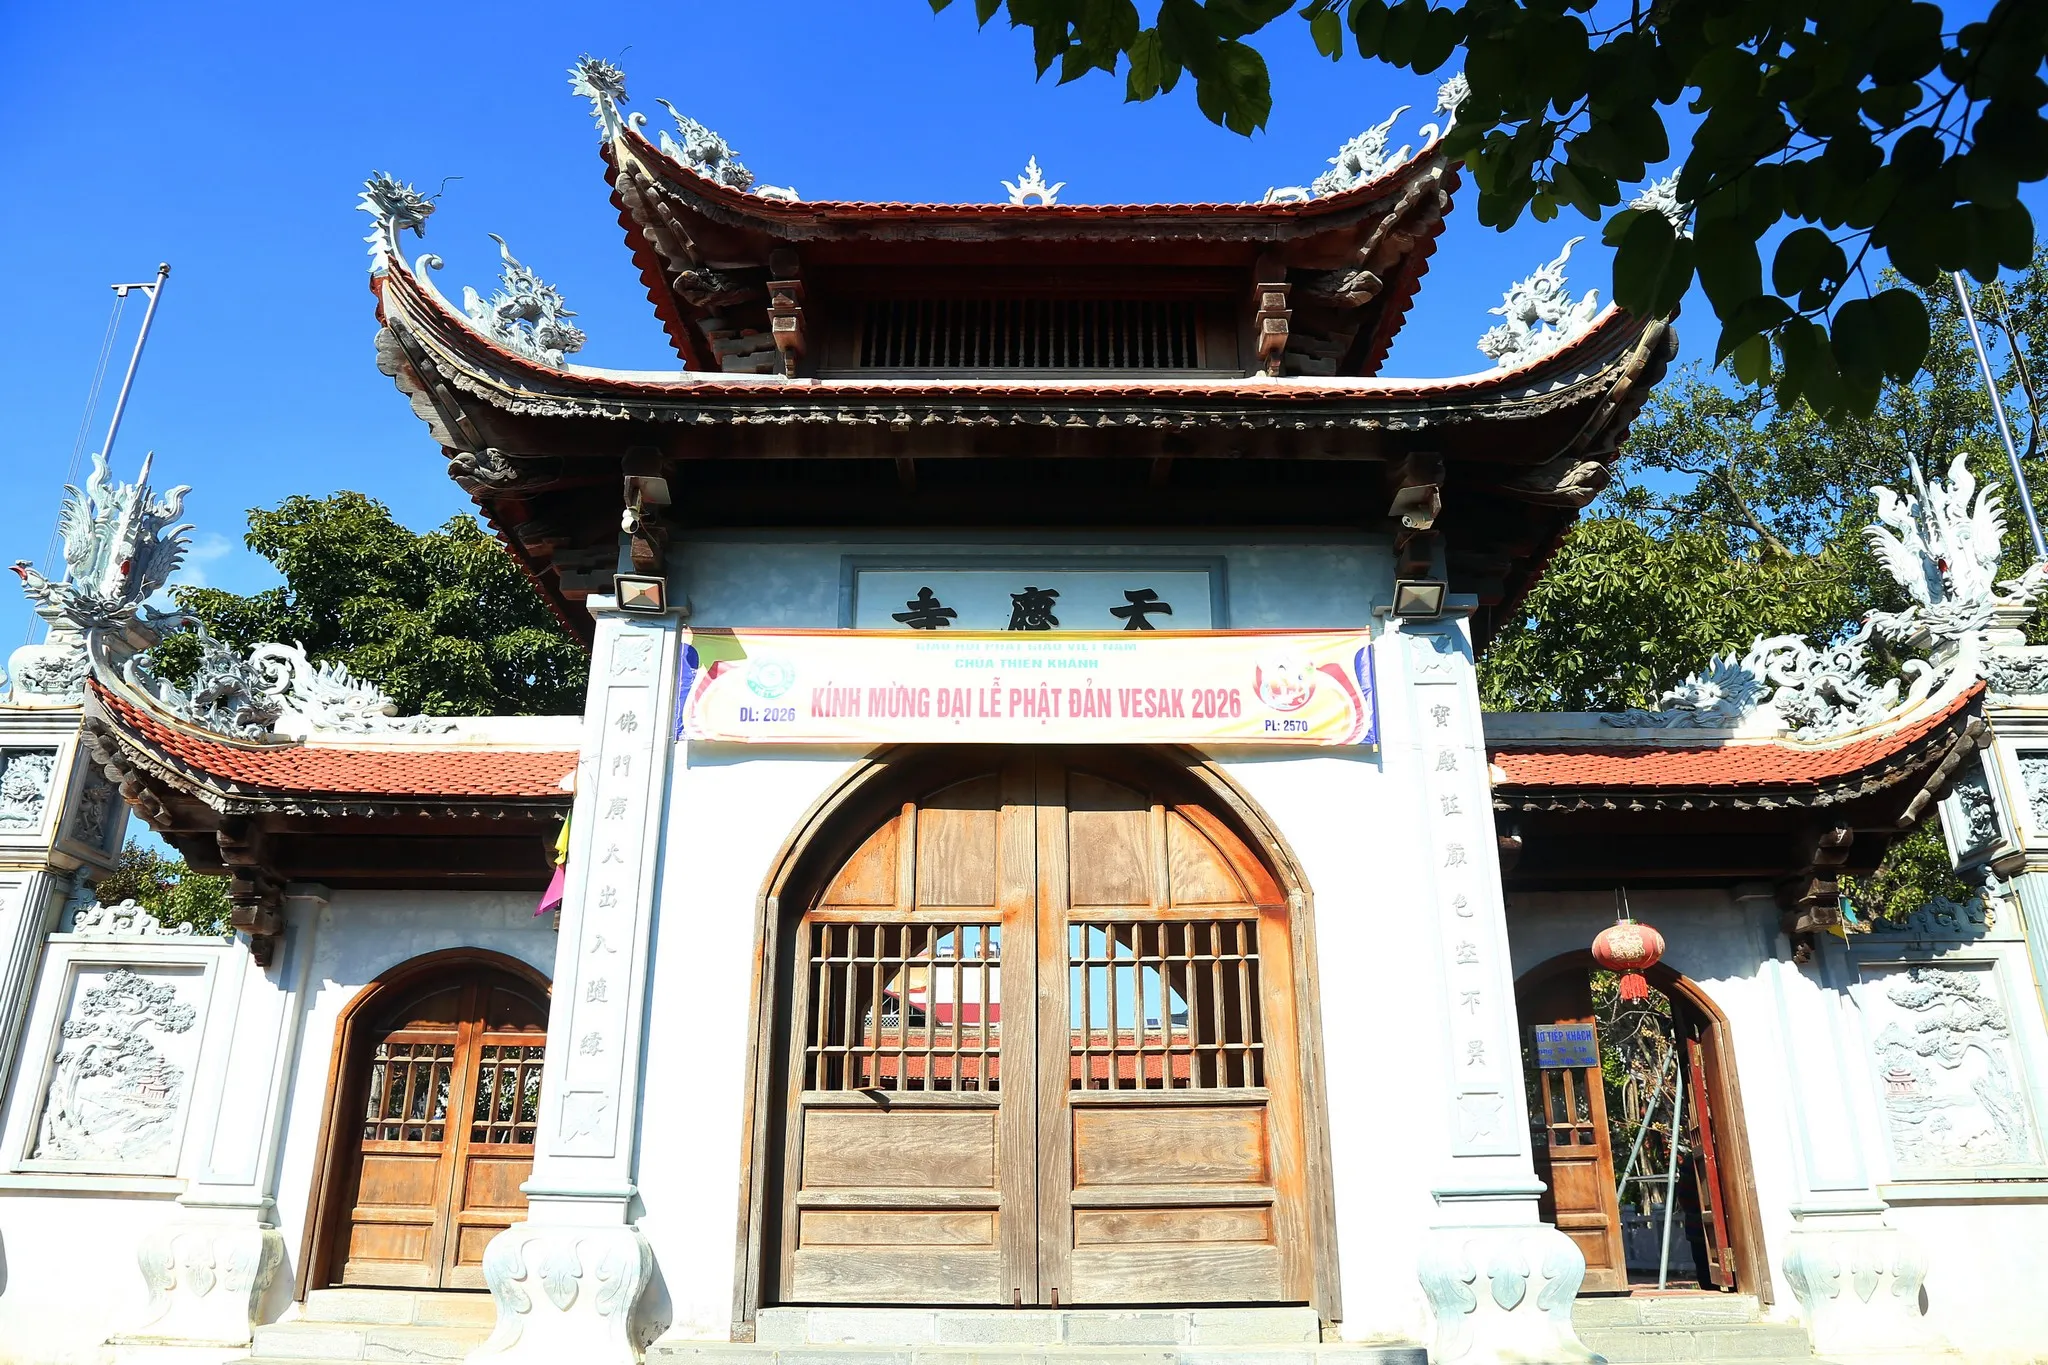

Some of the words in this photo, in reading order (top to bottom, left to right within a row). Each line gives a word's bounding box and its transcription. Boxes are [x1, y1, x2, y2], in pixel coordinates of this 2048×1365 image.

[811, 681, 861, 718] KÍNH
[868, 681, 930, 718] MỪNG
[937, 688, 971, 725] ĐẠI
[979, 676, 1002, 718] LỄ
[1009, 682, 1062, 725] PHẬT
[1068, 678, 1112, 718] ĐẢN
[1118, 688, 1185, 718] VESAK
[1191, 688, 1241, 718] 2026
[740, 707, 759, 722] DL:
[763, 707, 796, 722] 2026
[1265, 719, 1280, 732] PL:
[1283, 719, 1308, 732] 2570
